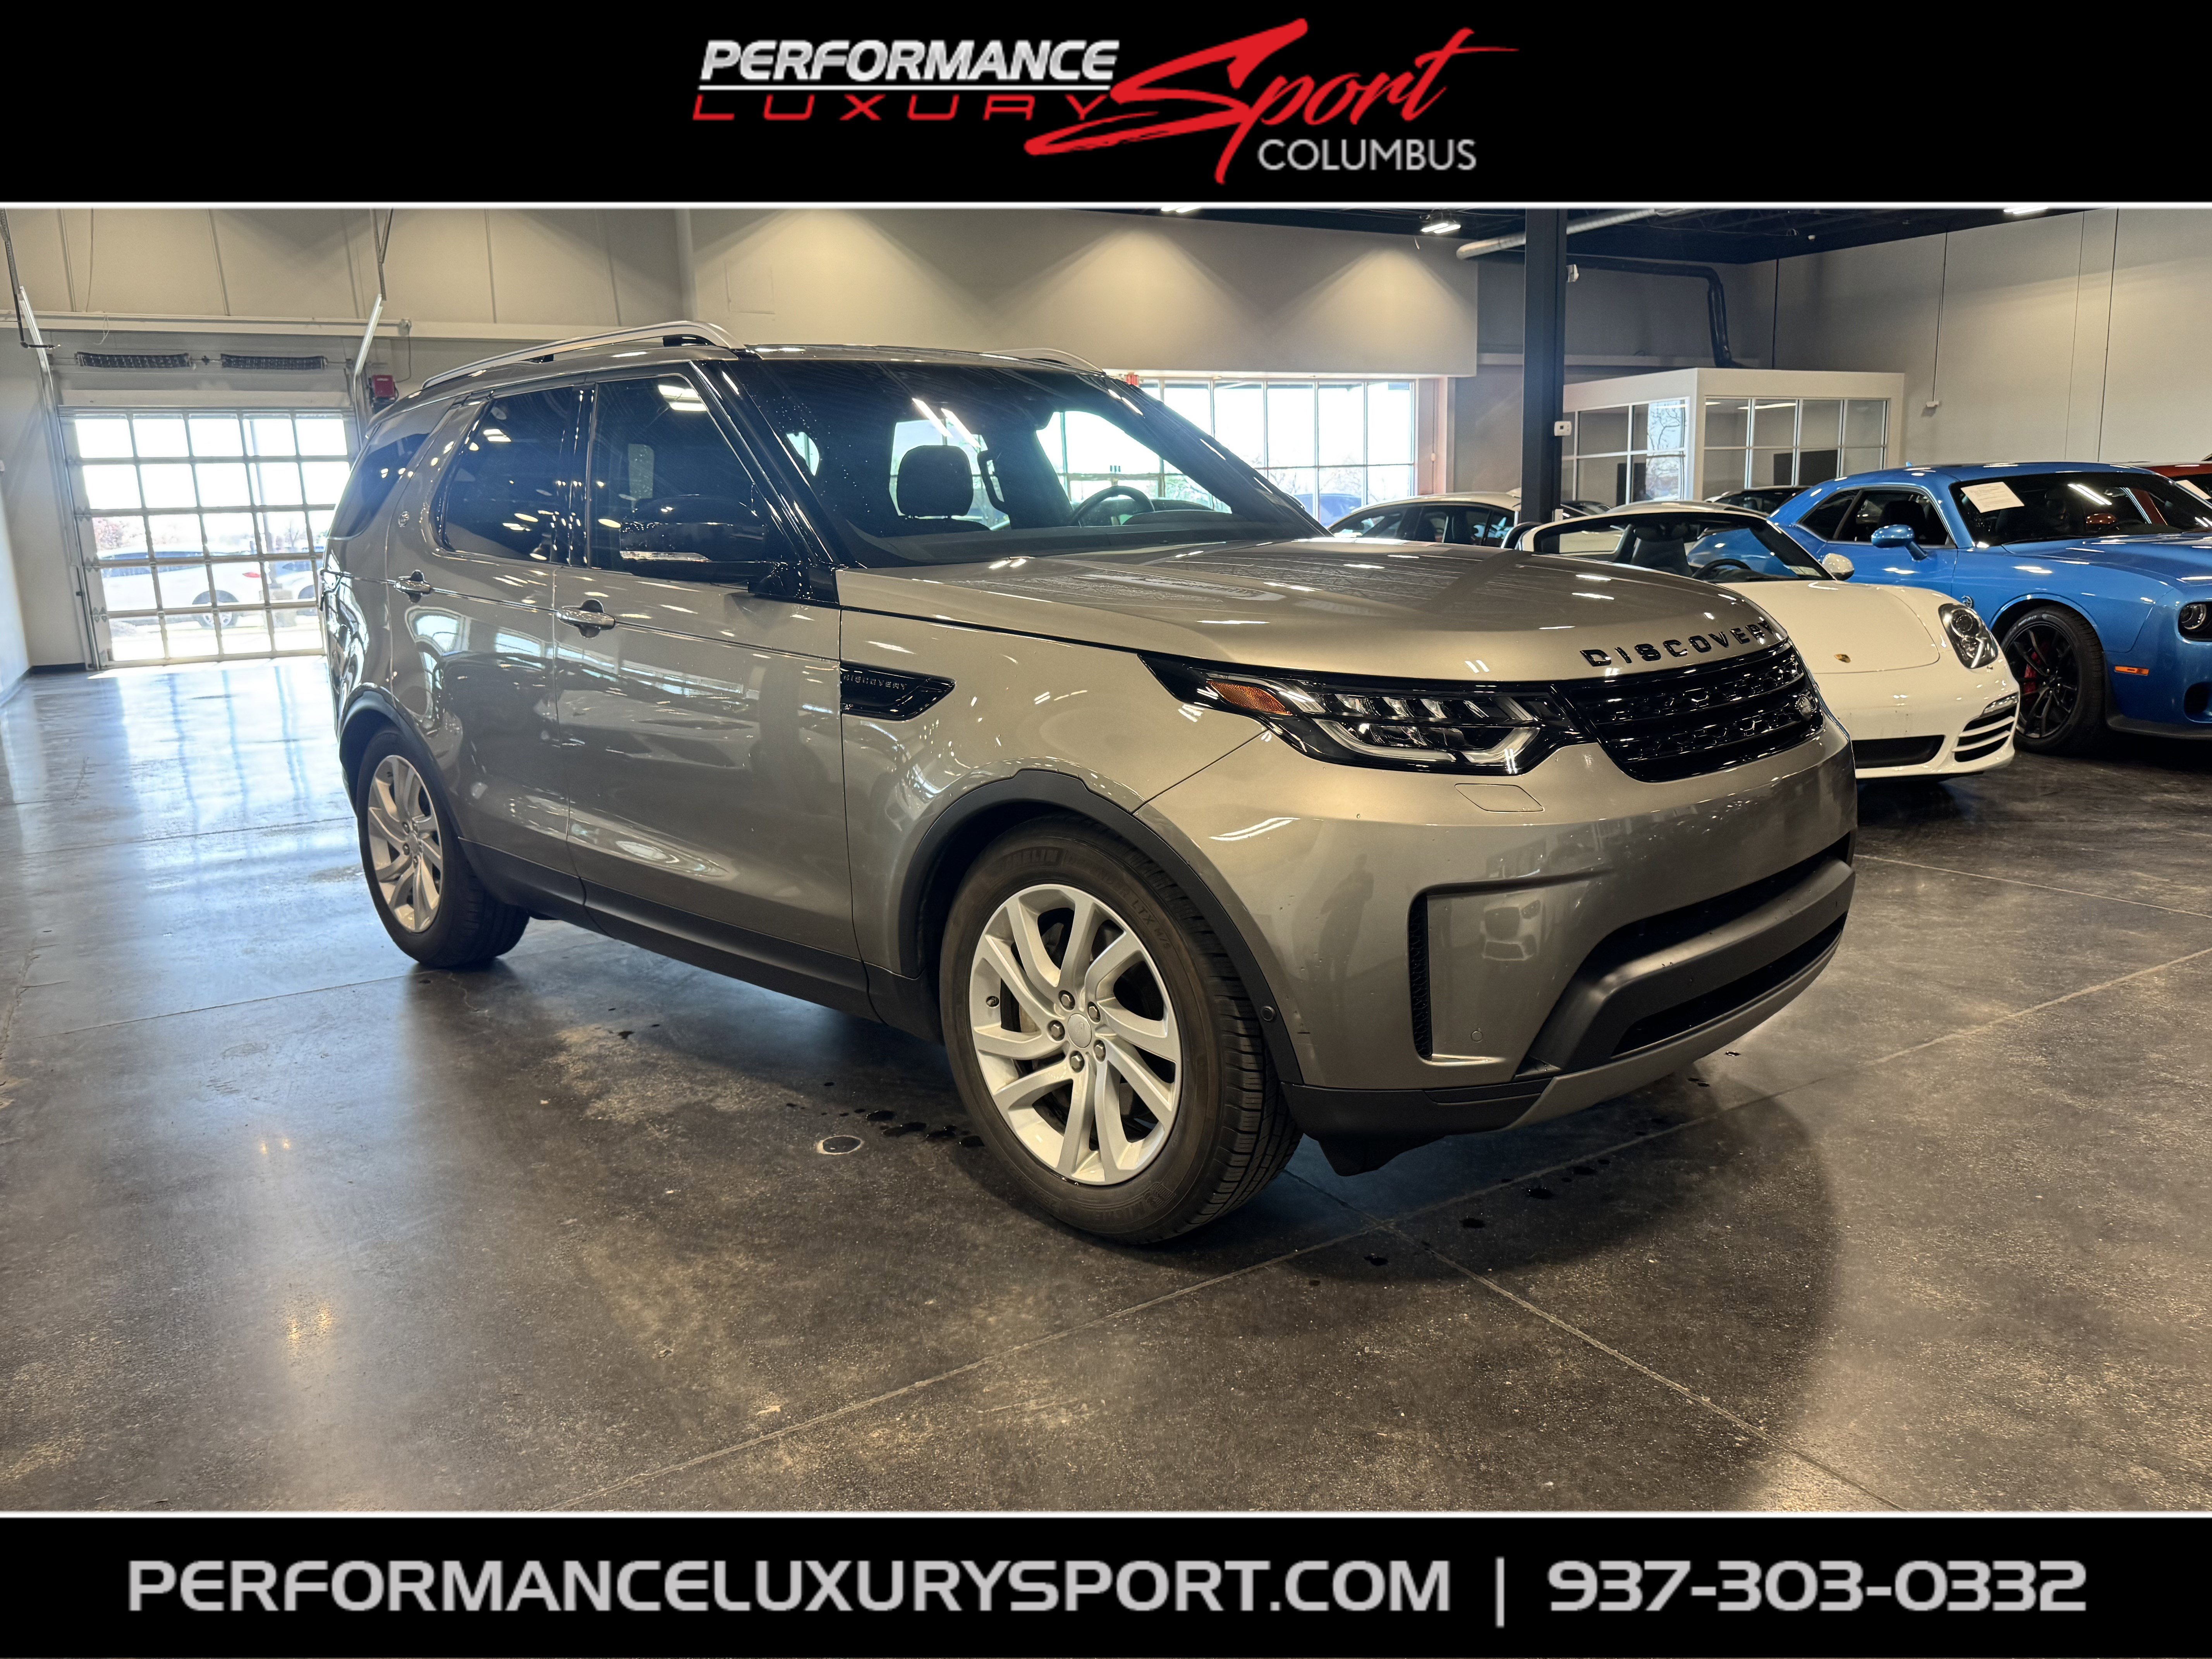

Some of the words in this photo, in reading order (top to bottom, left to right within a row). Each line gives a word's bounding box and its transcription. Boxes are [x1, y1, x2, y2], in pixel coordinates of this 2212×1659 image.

[1580, 618, 1772, 667] DISCOVERY
[1132, 899, 1155, 926] LTX
[1156, 927, 1171, 949] M/S
